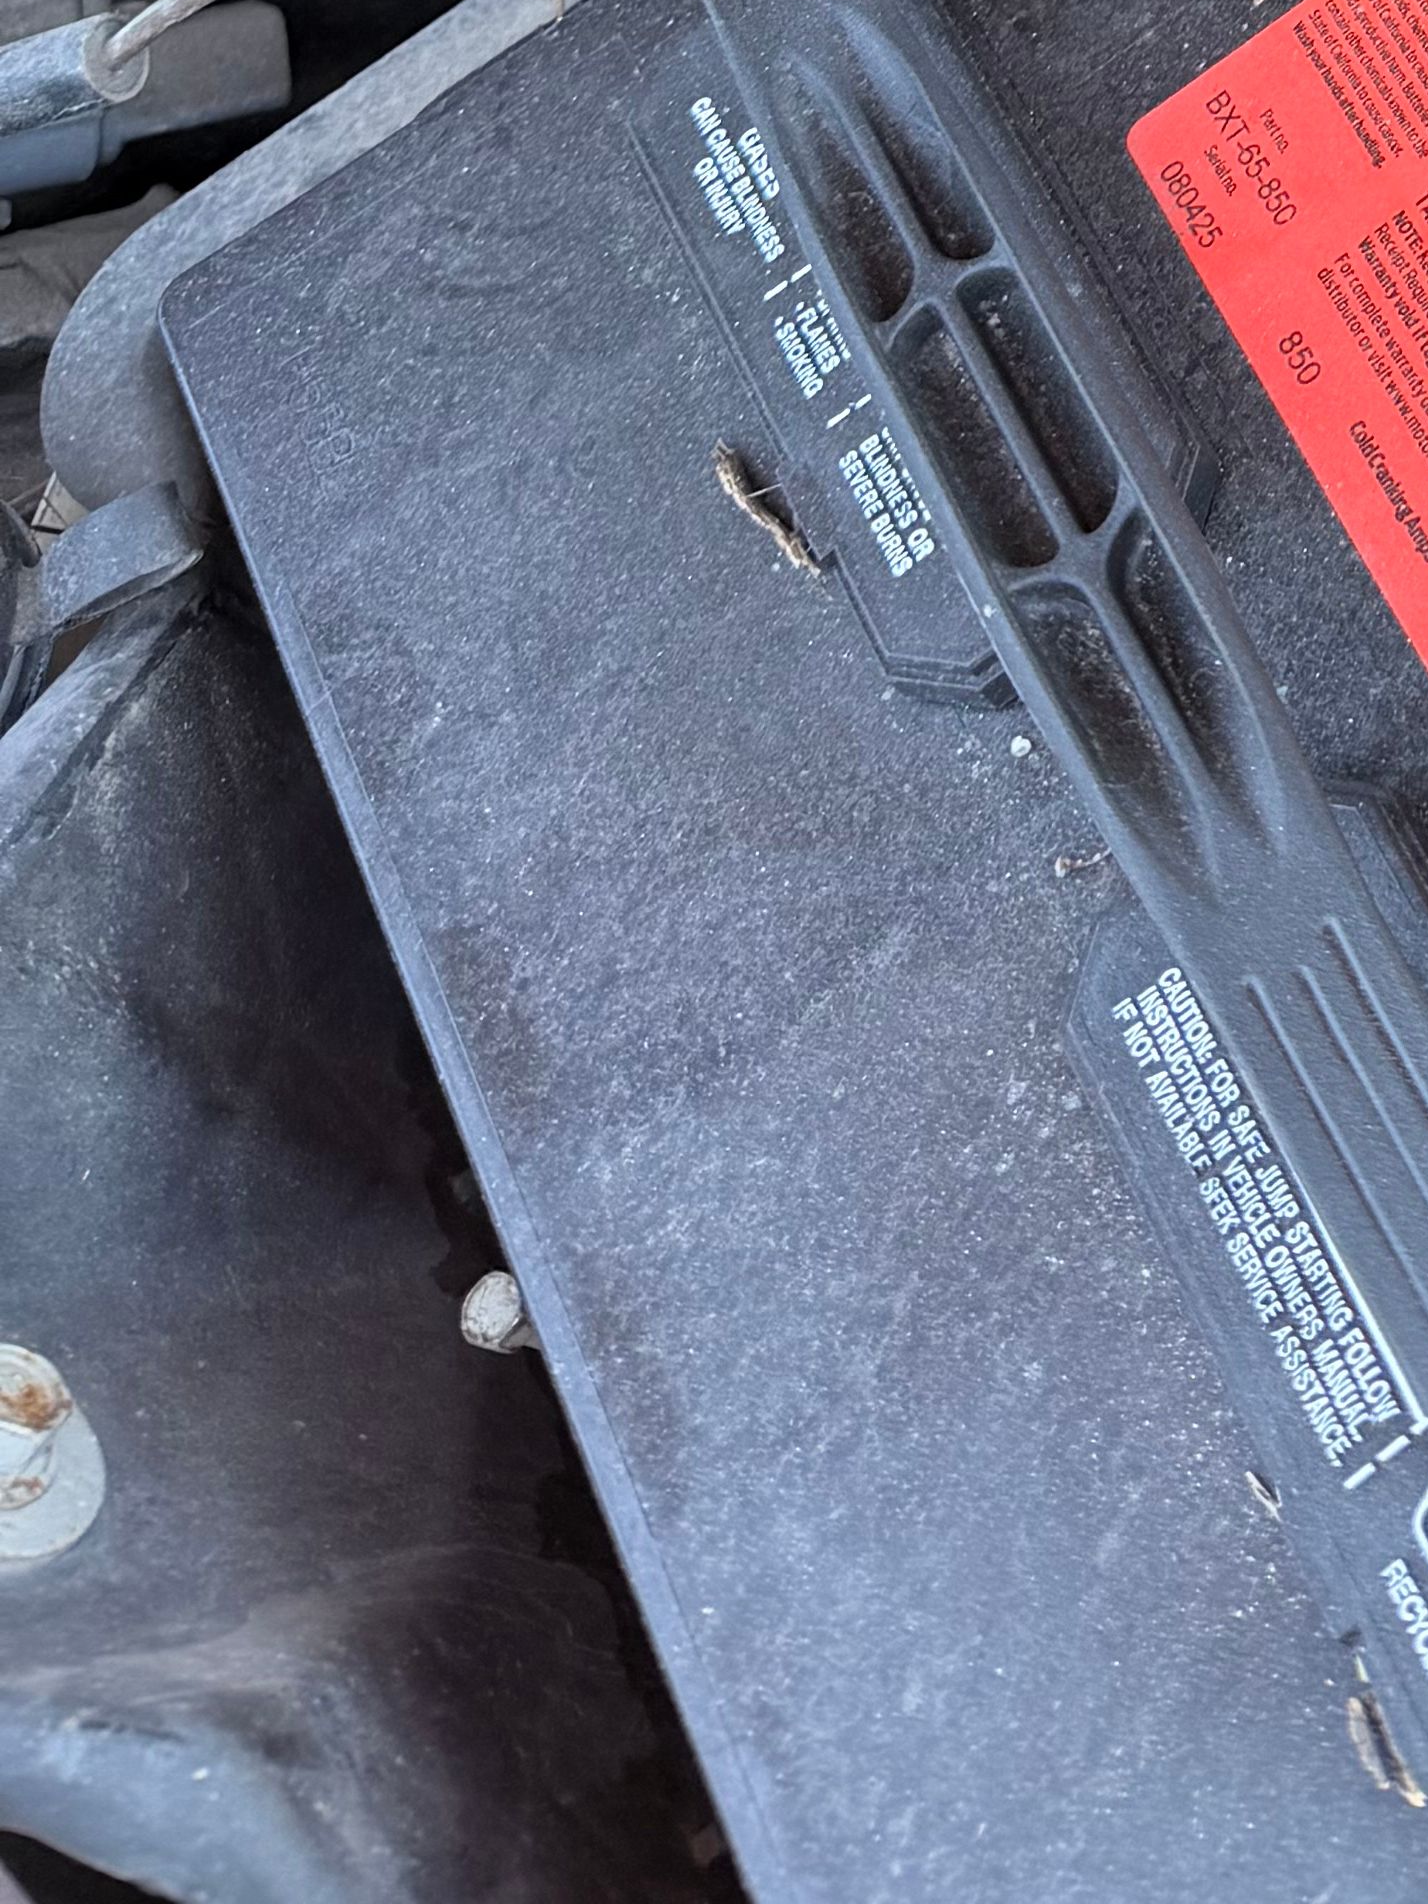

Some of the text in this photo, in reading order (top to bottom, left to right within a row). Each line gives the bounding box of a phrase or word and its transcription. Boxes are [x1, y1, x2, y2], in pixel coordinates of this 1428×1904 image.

[1372, 0, 1389, 12] of
[1378, 8, 1411, 54] California
[1292, 20, 1386, 169] Wash your hands after handling.
[1308, 9, 1404, 158] State of California to cause cancer.
[1405, 49, 1418, 63] to
[1203, 145, 1237, 197] Serial no.
[1205, 89, 1297, 225] BXT-65-850
[1259, 108, 1289, 154] Part no.
[690, 96, 785, 263] CAN CAUSE BLINDNESS
[692, 157, 746, 236] OR INJURY
[1160, 160, 1223, 248] 080425
[1374, 222, 1411, 274] Receipt
[1392, 209, 1424, 255] NOTE:
[1317, 267, 1365, 337] distributor
[1358, 335, 1373, 352] or
[1367, 350, 1393, 383] visit
[1334, 252, 1355, 278] For
[1349, 277, 1391, 339] complete
[1385, 336, 1427, 398] warranty
[1358, 235, 1400, 300] Warranty
[1393, 296, 1421, 330] void
[1278, 331, 1321, 385] 850
[838, 449, 885, 520] SEVERE
[869, 512, 913, 578] BURNS
[858, 433, 918, 530] BLINDNESS
[906, 528, 935, 563] OR
[1349, 420, 1380, 459] Cold
[1367, 452, 1414, 523] Cranking
[1110, 997, 1139, 1022] IF
[1121, 1020, 1161, 1069] NOT
[1136, 984, 1221, 1133] INSTRUCTIONS
[1207, 1129, 1237, 1161] IN
[1157, 967, 1402, 1424] CAUTION: FOR SAFE JUMP STARTING FOLLOW
[1221, 1155, 1282, 1249] VEHICLE
[1224, 1232, 1284, 1324] SERVICE
[1263, 1245, 1325, 1341] OWNERS
